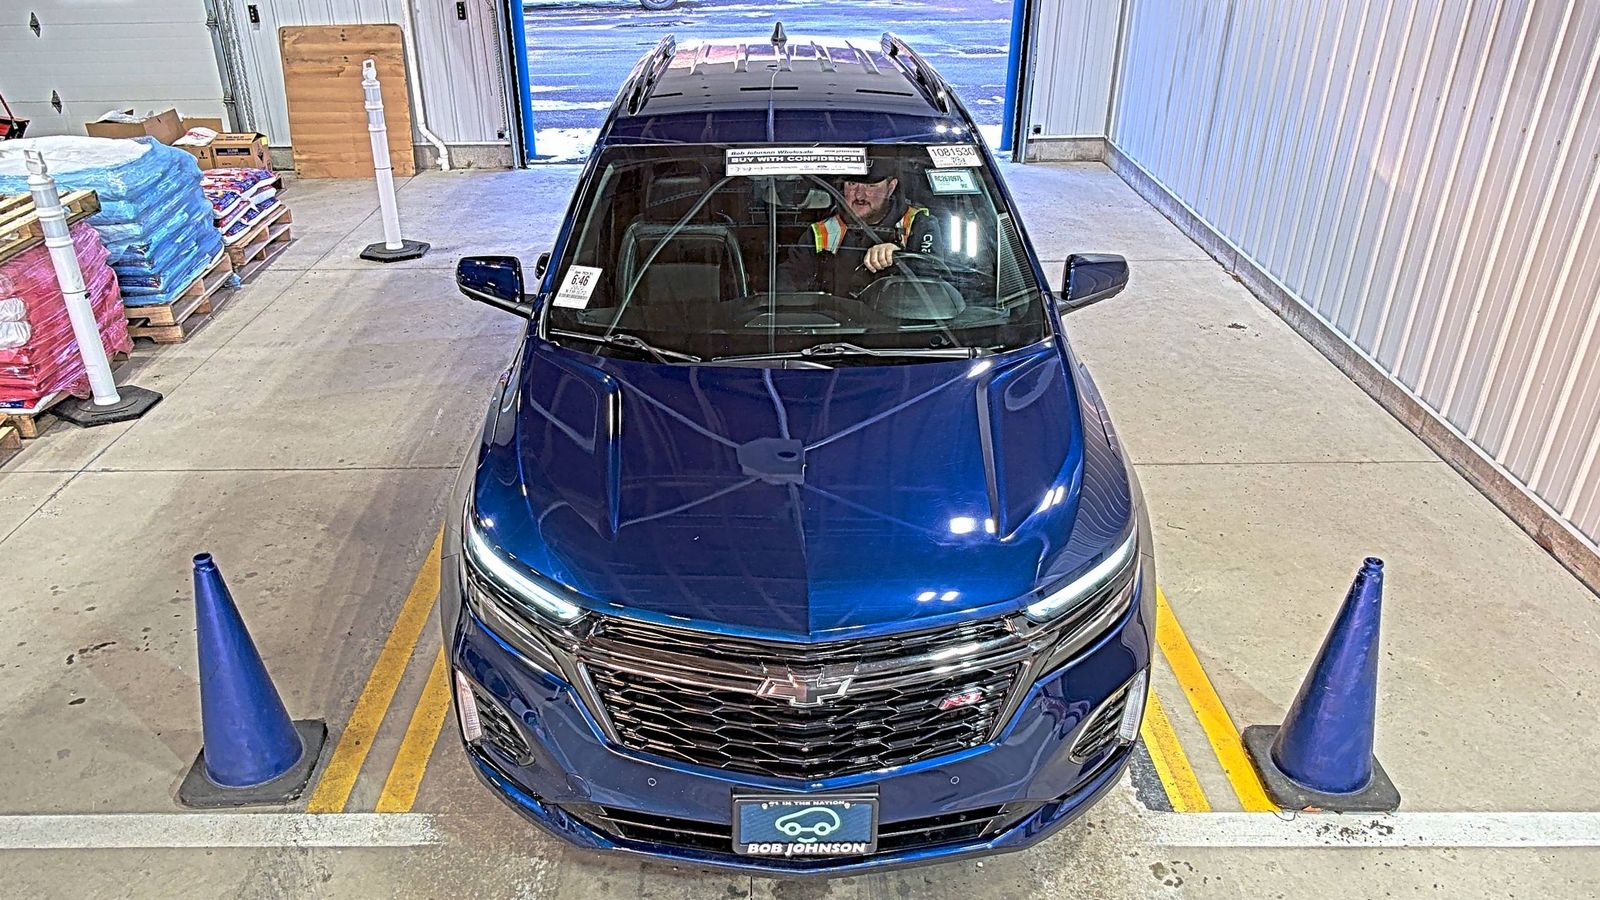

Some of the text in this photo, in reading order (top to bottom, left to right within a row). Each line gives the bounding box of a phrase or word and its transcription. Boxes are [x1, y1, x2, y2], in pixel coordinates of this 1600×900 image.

[931, 147, 975, 157] 1081530
[571, 274, 590, 287] 6:46
[747, 842, 866, 857] BOB JOHNSON
